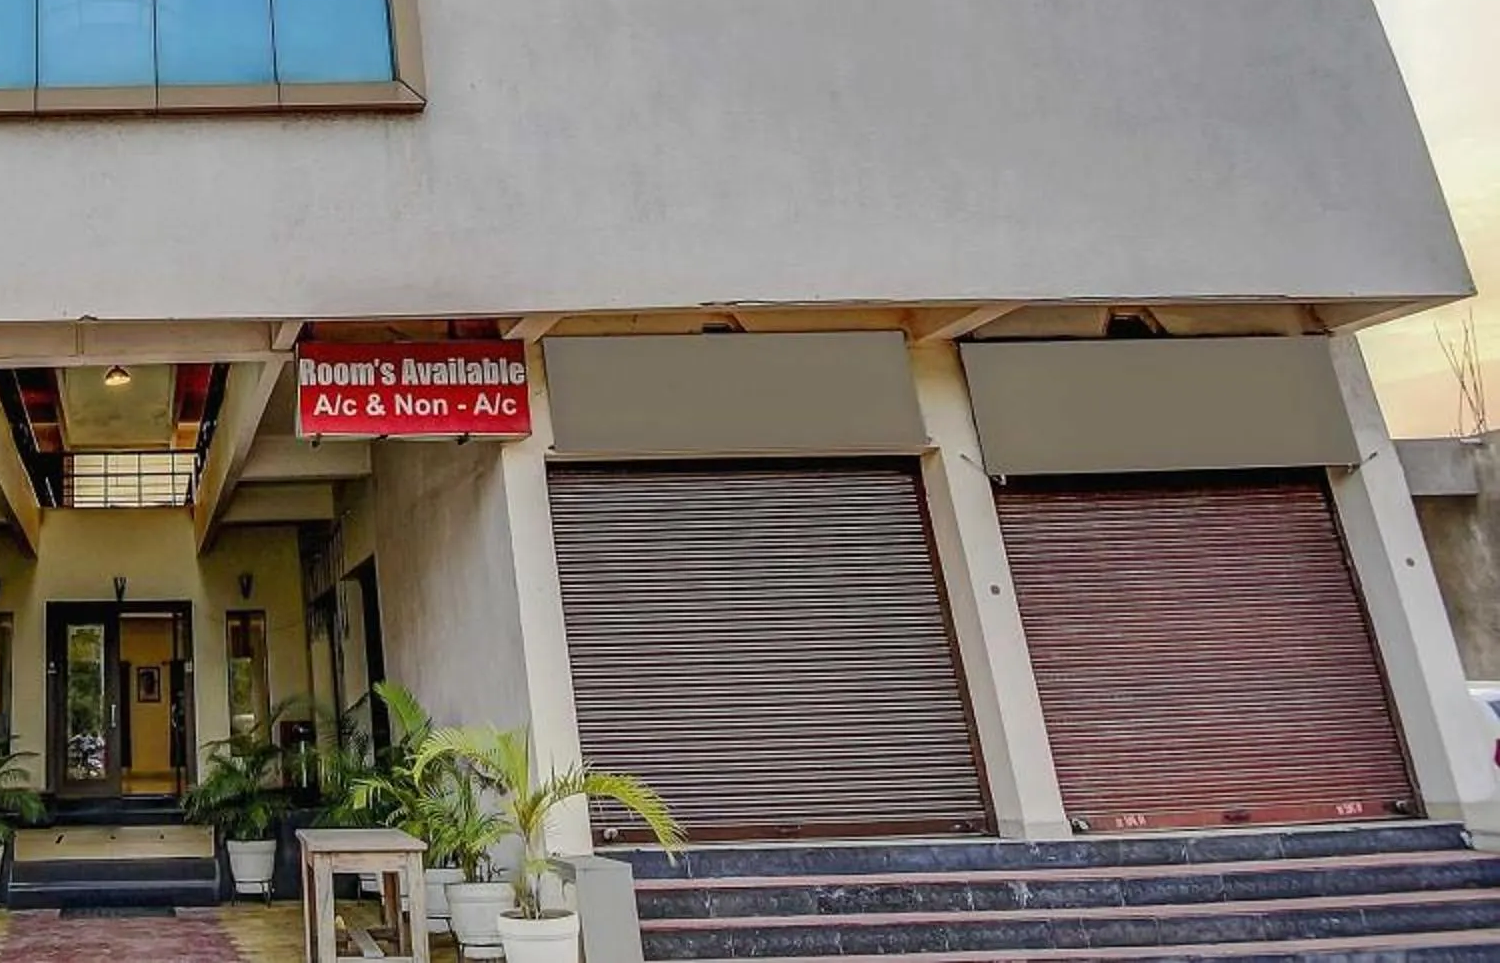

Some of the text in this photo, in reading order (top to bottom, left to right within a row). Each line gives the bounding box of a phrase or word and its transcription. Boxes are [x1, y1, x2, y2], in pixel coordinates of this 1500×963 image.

[300, 358, 525, 386] Room's Available
[313, 393, 357, 416] A/c
[366, 393, 386, 416] &
[394, 393, 449, 416] Non
[473, 392, 517, 416] A/c
